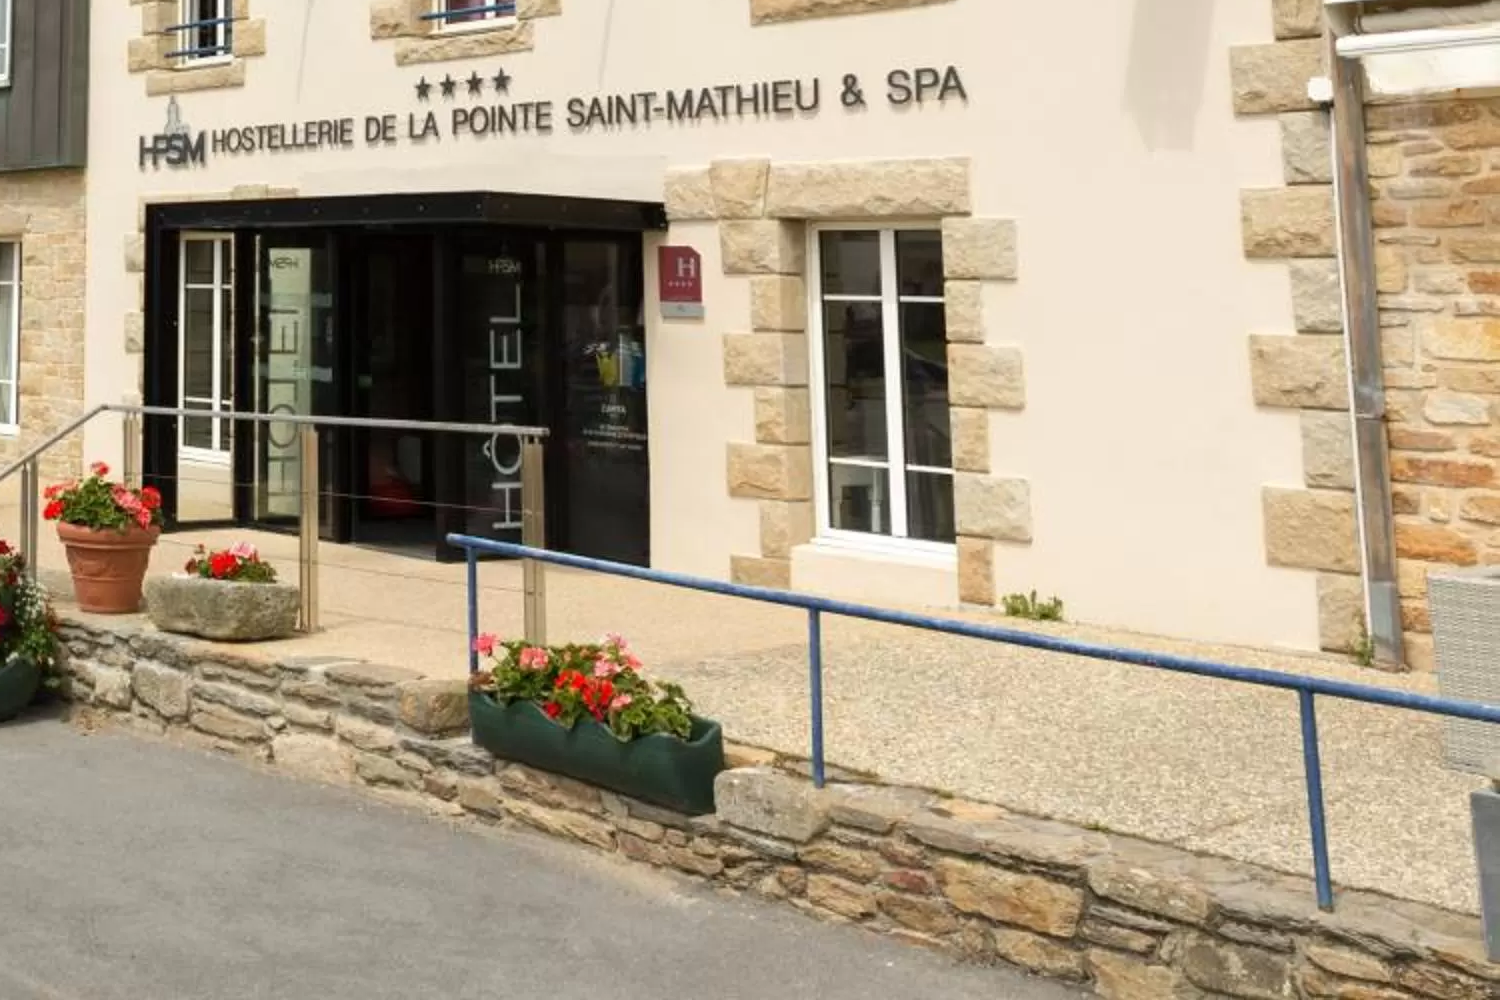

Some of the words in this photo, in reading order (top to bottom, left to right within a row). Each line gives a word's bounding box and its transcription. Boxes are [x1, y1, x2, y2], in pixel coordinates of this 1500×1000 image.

[211, 117, 354, 154] HOSTELLERIE
[364, 114, 398, 144] DE
[408, 110, 440, 140] LA
[451, 100, 553, 137] POINTE
[565, 77, 820, 129] SAINT-MATHIEU
[839, 73, 867, 108] &
[886, 65, 968, 105] SPA
[676, 256, 696, 278] H
